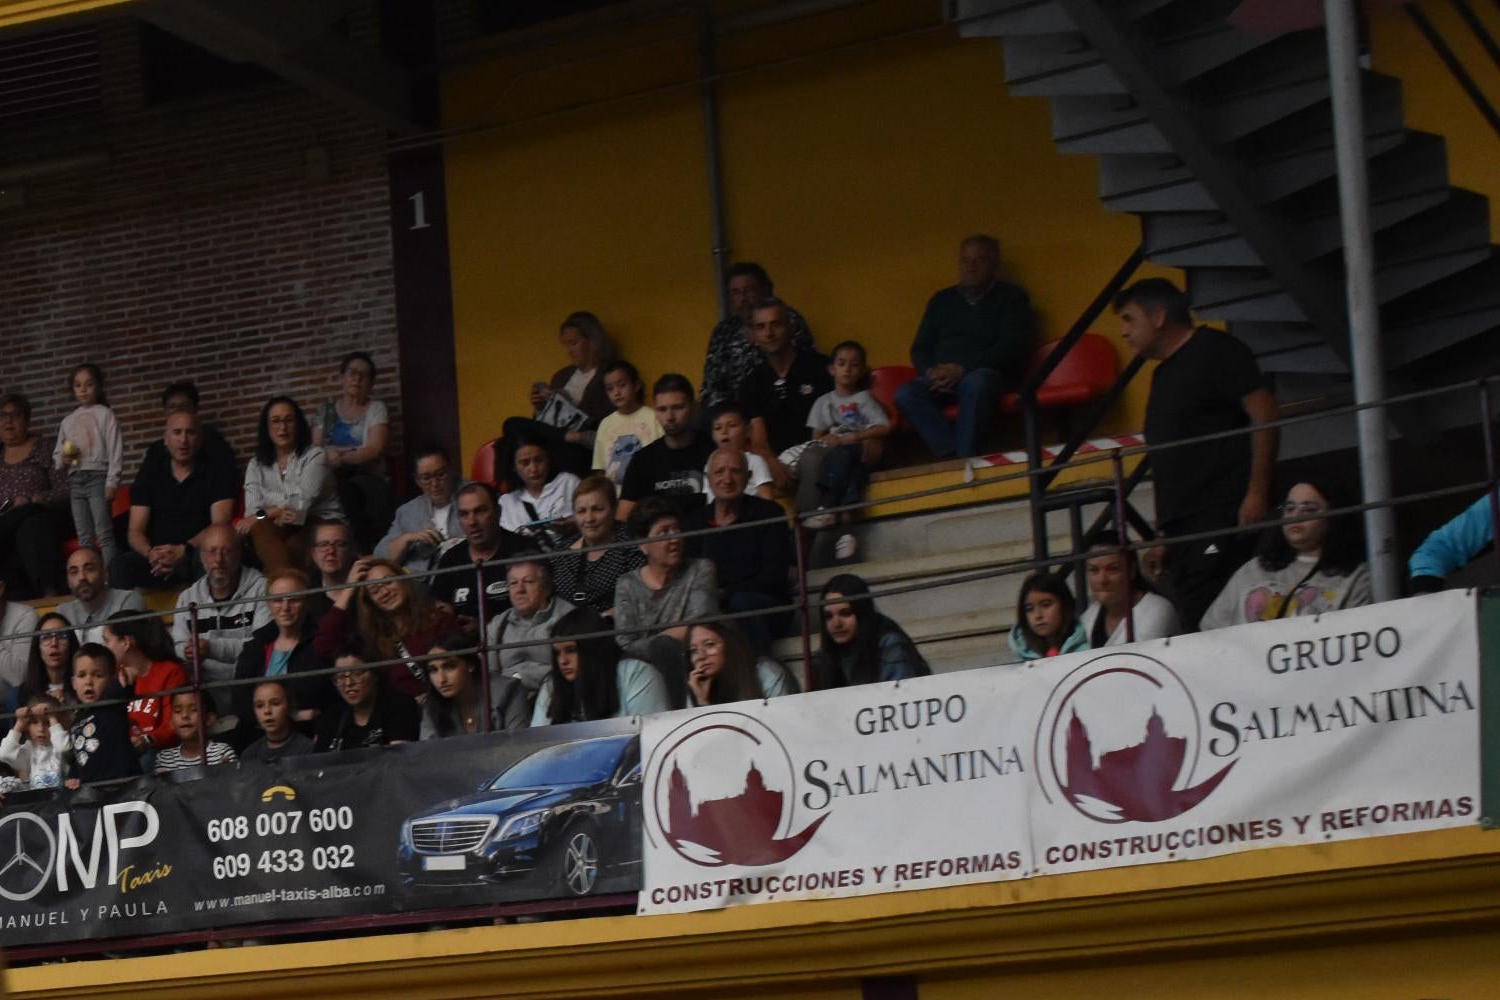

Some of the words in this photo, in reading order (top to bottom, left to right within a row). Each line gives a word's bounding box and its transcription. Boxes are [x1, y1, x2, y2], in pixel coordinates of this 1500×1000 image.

[408, 190, 431, 230] 1
[1267, 626, 1402, 675] GRUPO
[854, 694, 967, 736] GRUPO
[1208, 679, 1477, 757] SALMANTINA
[803, 745, 1026, 811] SALMANTINA
[207, 814, 250, 844] 608
[255, 811, 303, 840] 007
[308, 805, 354, 835] 600
[1045, 819, 1283, 866] CONSTRUCCIONES
[1293, 815, 1311, 835] Y
[1321, 796, 1474, 832] REFORMAS
[117, 862, 174, 894] Taxis
[212, 852, 252, 882] 609
[257, 847, 304, 874] 433
[312, 844, 355, 871] 032
[651, 868, 865, 906] CONSTRUCCIONES
[873, 865, 888, 885] Y
[895, 850, 1022, 882] REFORMAS
[80, 908, 90, 924] Y
[98, 900, 169, 921] PAULA
[193, 882, 386, 913] www.manuel-taxis-alba.com
